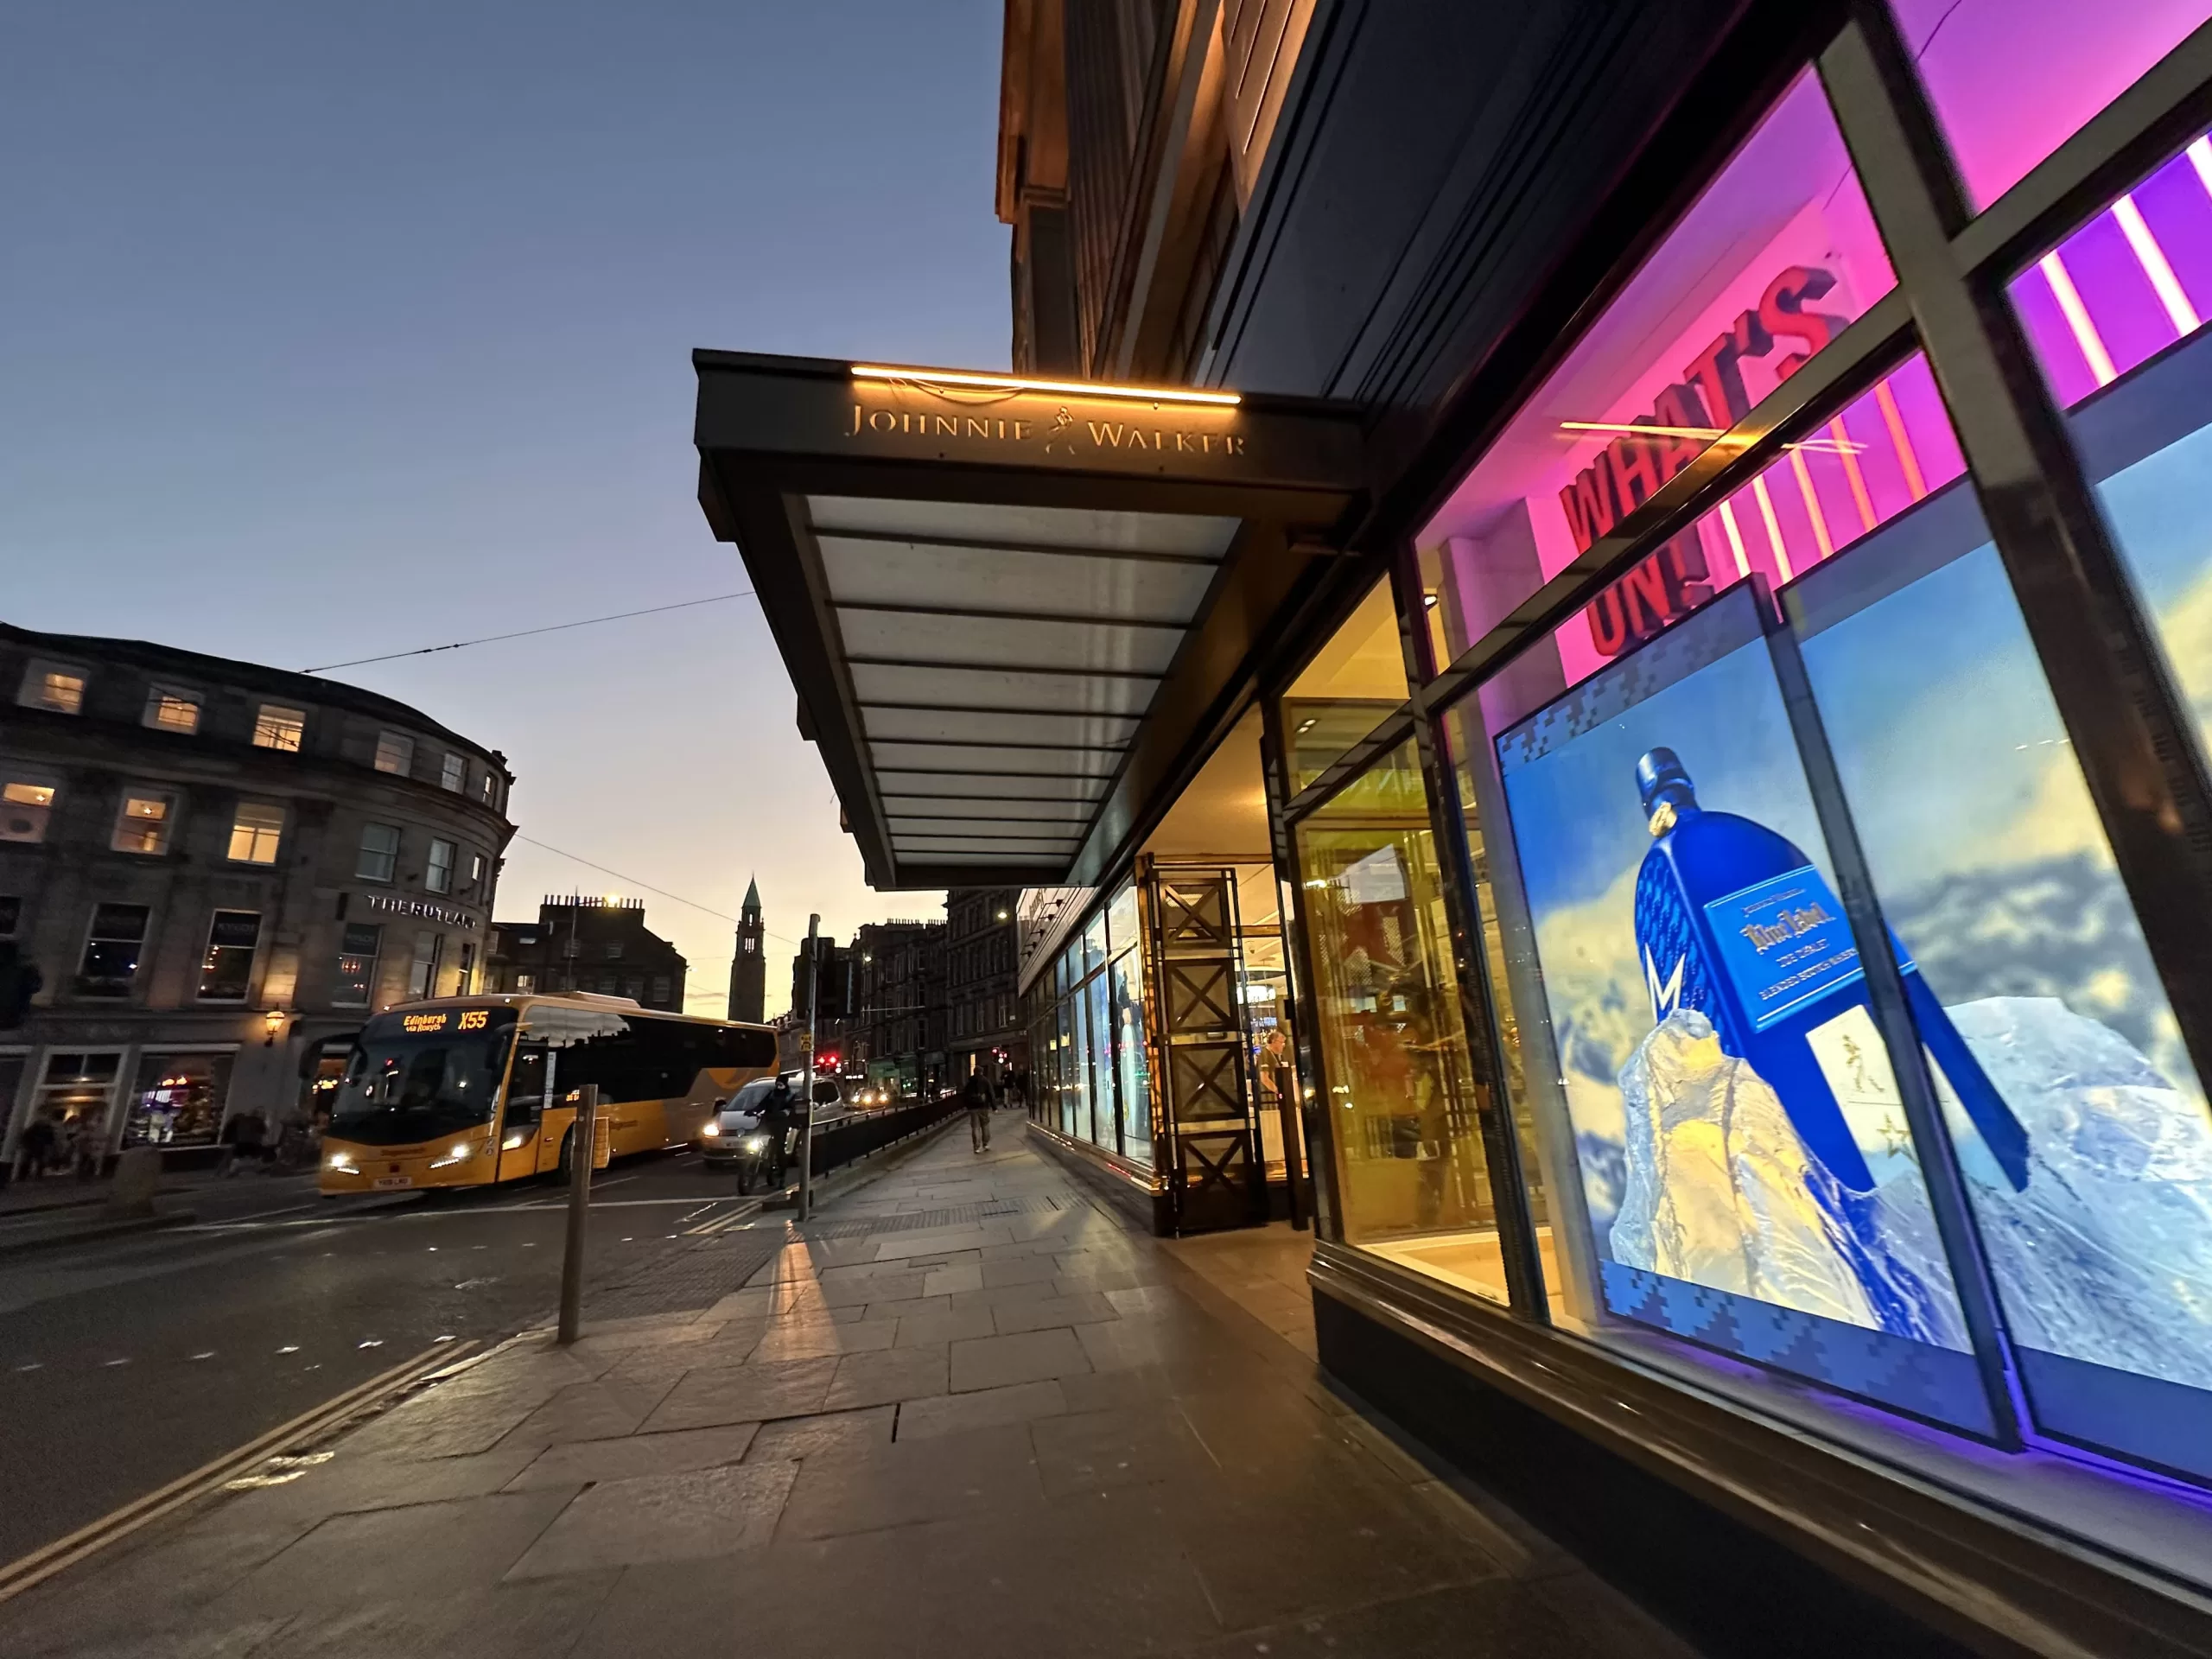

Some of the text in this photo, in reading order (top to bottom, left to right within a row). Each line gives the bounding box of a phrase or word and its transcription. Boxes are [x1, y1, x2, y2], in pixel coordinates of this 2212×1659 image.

[1559, 265, 1851, 556] WHAT'S
[844, 404, 1244, 456] JOHNNIE WALKER
[365, 894, 409, 915] THE
[404, 1010, 489, 1030] Edinburgh X55
